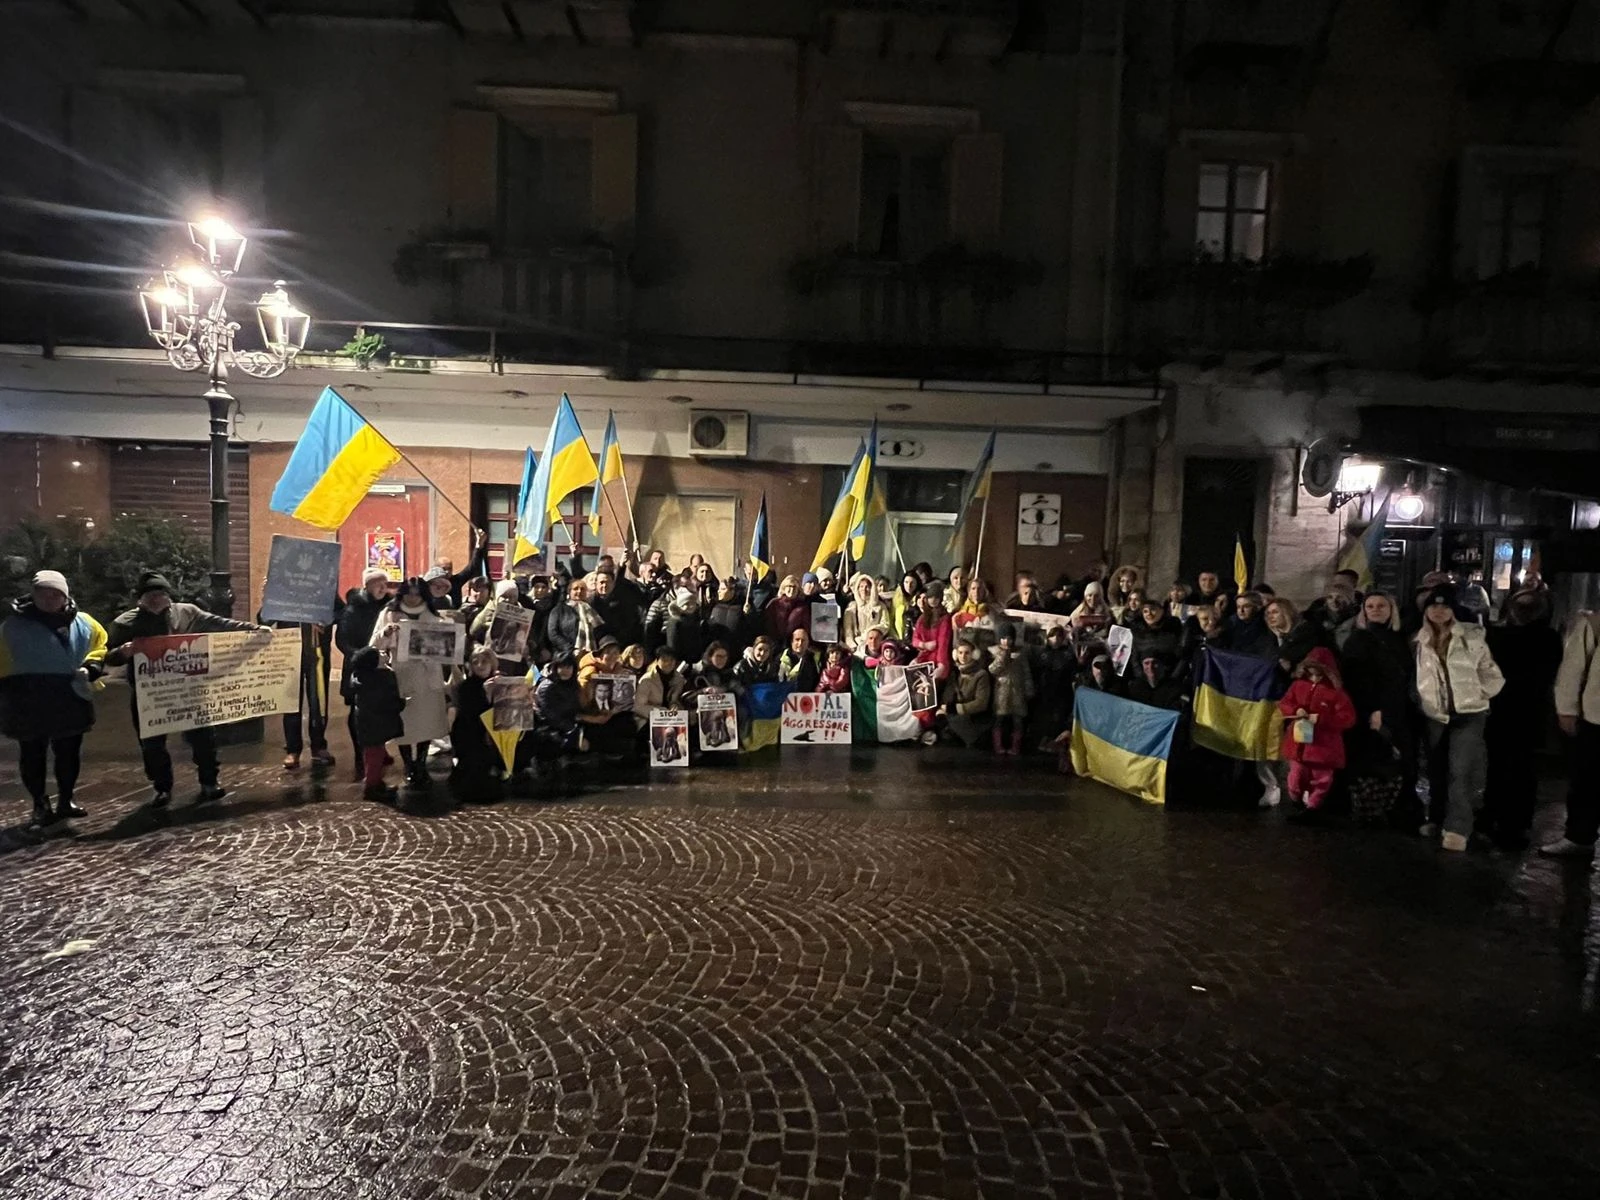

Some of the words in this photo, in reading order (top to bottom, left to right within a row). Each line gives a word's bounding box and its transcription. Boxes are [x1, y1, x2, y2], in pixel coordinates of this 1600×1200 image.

[784, 695, 820, 714] NO!
[823, 693, 843, 709] AL
[148, 713, 193, 726] CULTURA
[783, 717, 849, 732] AGGRESSORE
